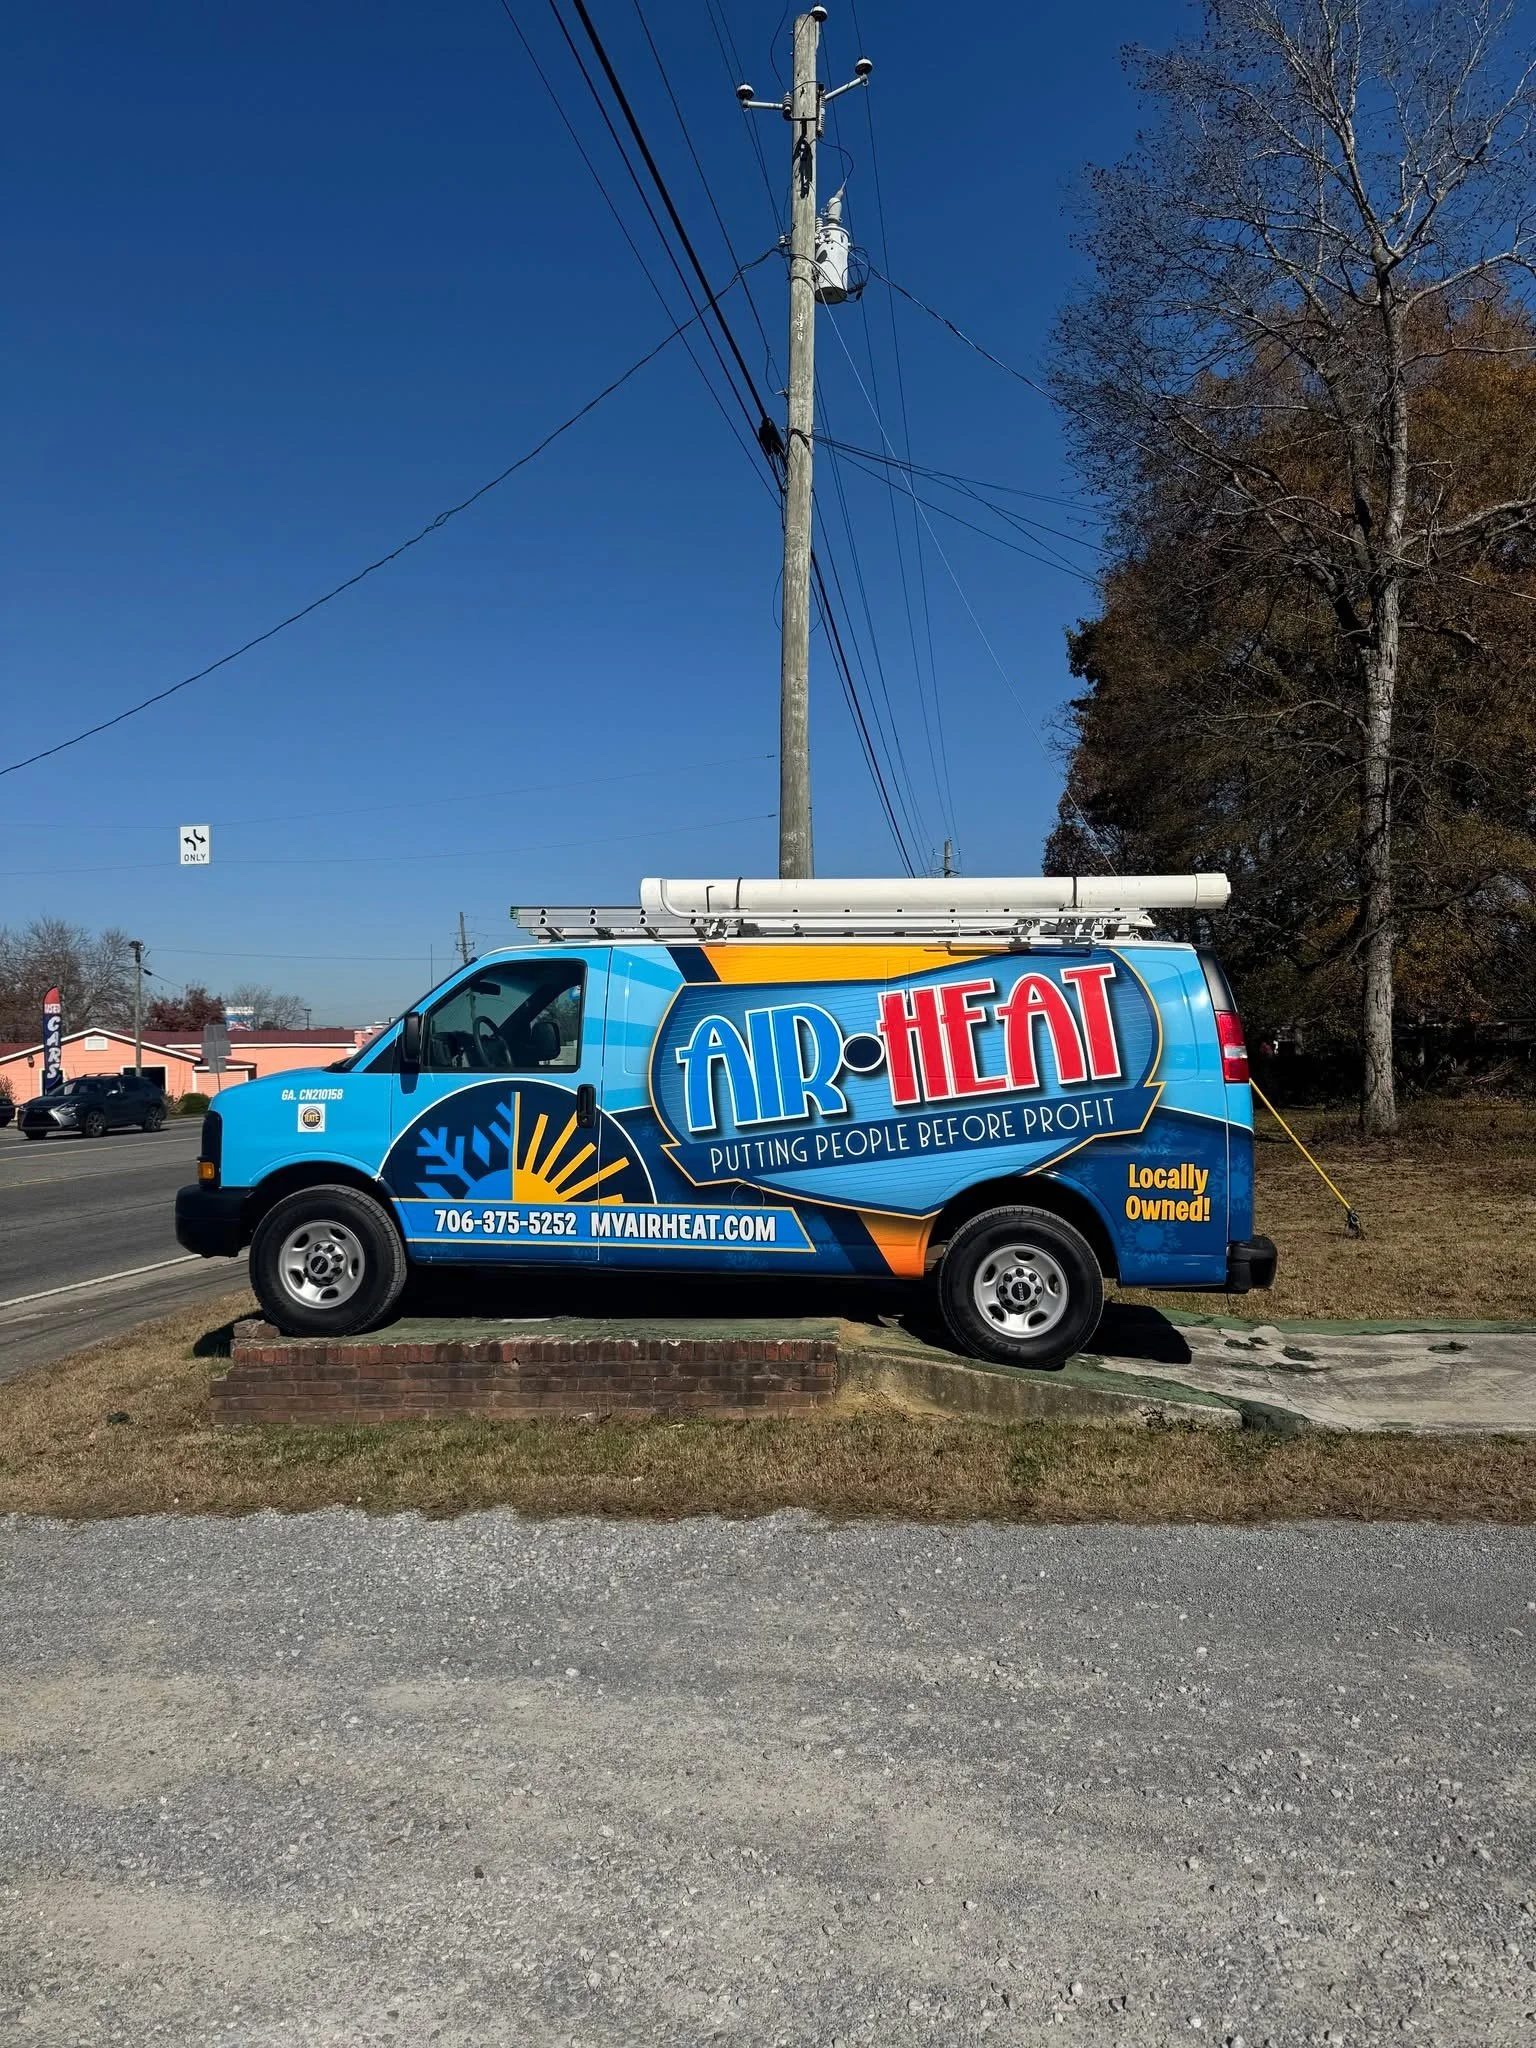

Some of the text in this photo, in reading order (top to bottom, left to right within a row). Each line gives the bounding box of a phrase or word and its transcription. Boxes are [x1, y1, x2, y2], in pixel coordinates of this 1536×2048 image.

[184, 853, 206, 862] ONLY
[46, 1015, 61, 1079] CARS
[281, 1088, 344, 1101] GA. CN210158
[710, 1098, 1115, 1173] PUTTING PEOPLE BEFORE PROFIT
[1129, 1163, 1209, 1195] Locally
[1125, 1195, 1211, 1222] Owned!
[434, 1209, 776, 1242] 706-375-5252 MYAIRHEAT.COM
